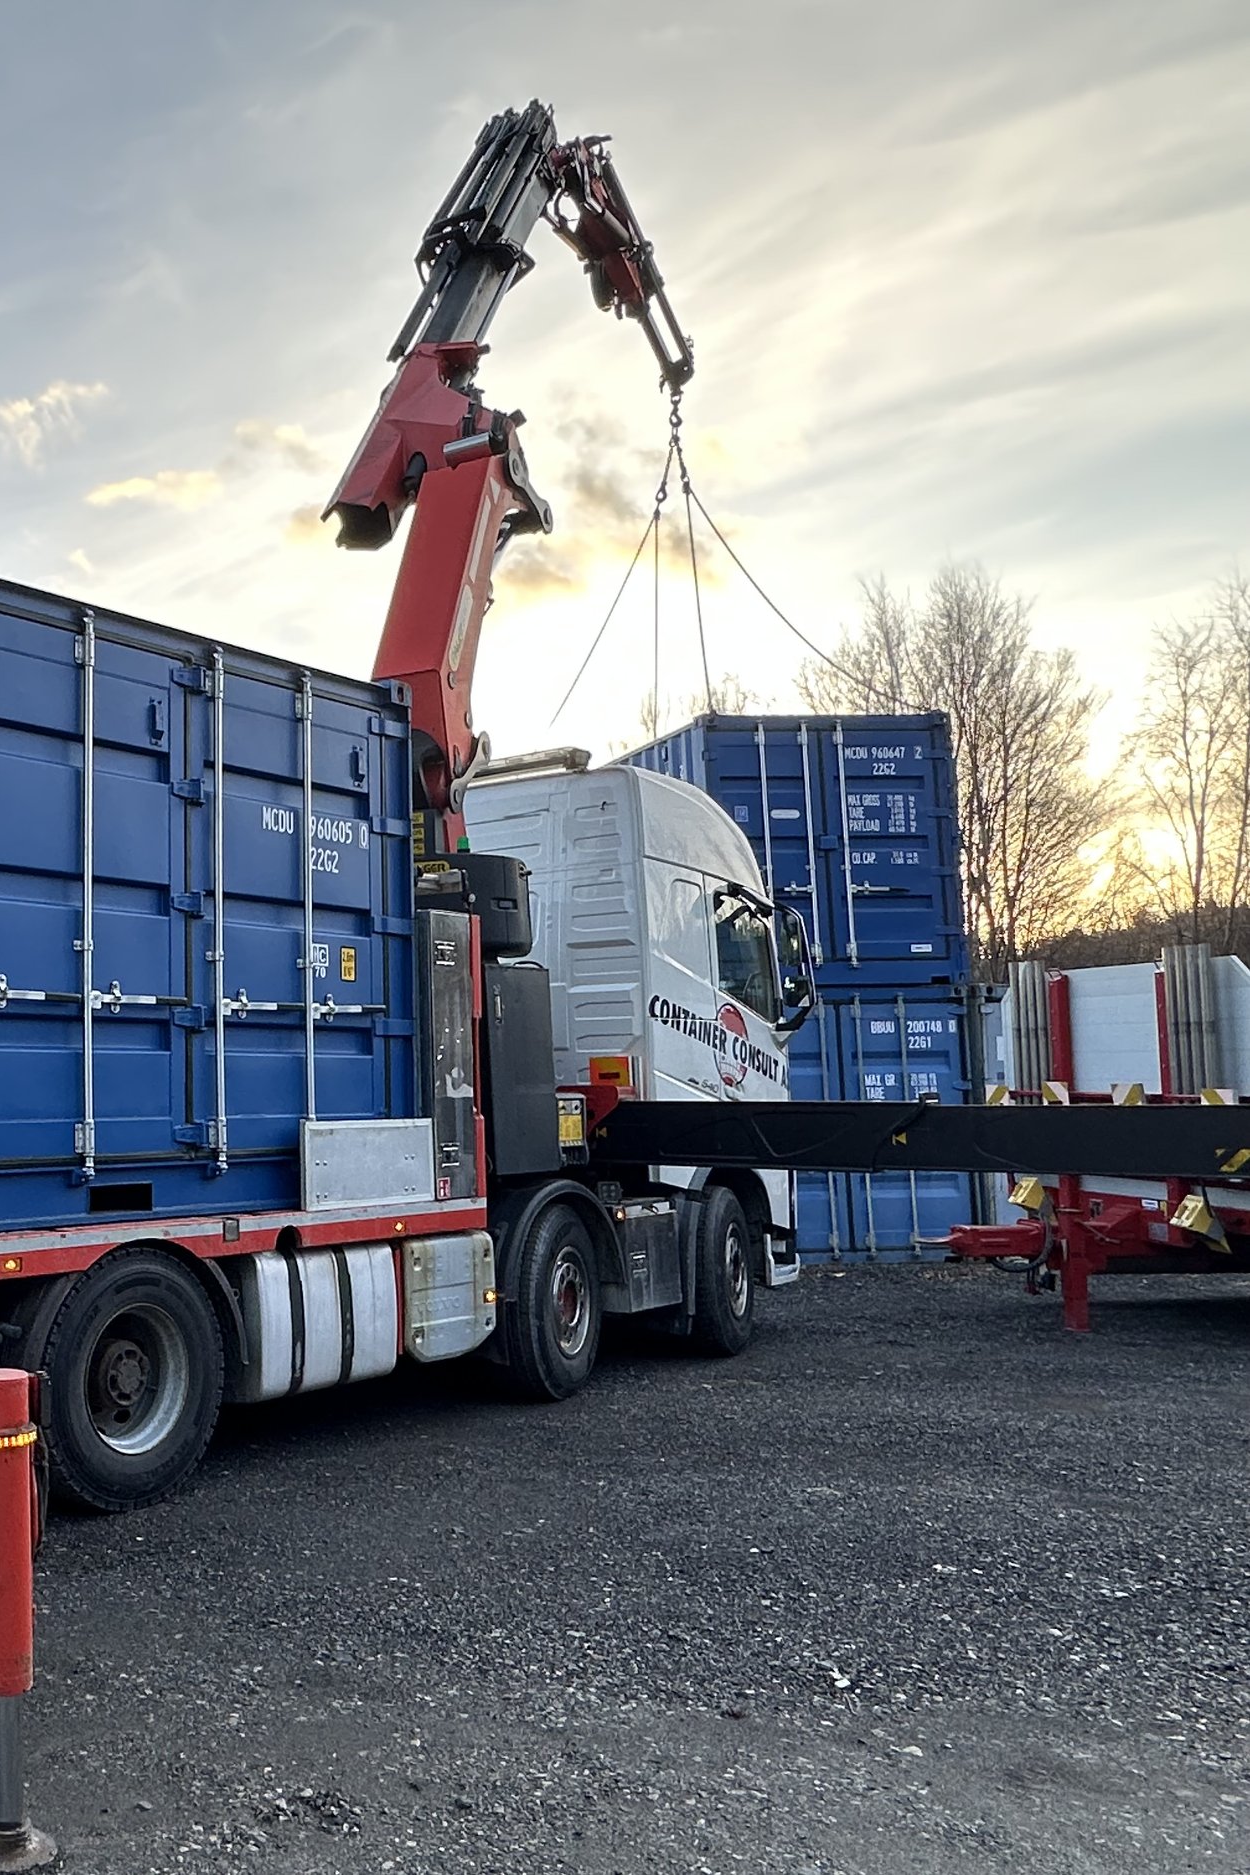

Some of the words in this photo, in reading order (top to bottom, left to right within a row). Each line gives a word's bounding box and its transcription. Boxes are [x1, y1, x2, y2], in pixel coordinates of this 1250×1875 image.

[844, 746, 868, 759] MCDU
[871, 746, 905, 759] 960647
[914, 745, 923, 759] 2
[872, 763, 896, 775] 22G2
[262, 805, 295, 834] MCDU
[310, 816, 353, 844] 960605
[849, 819, 881, 831] PAYLOAD
[310, 847, 339, 874] 22G2
[315, 966, 327, 977] 70
[906, 1020, 943, 1032] 200748
[948, 1020, 957, 1033] 0
[649, 995, 727, 1056] CONTAINER
[732, 1036, 779, 1083] CONSULT
[908, 1036, 932, 1048] 22G1
[864, 1074, 882, 1086] MAX
[865, 1086, 886, 1099] TARE
